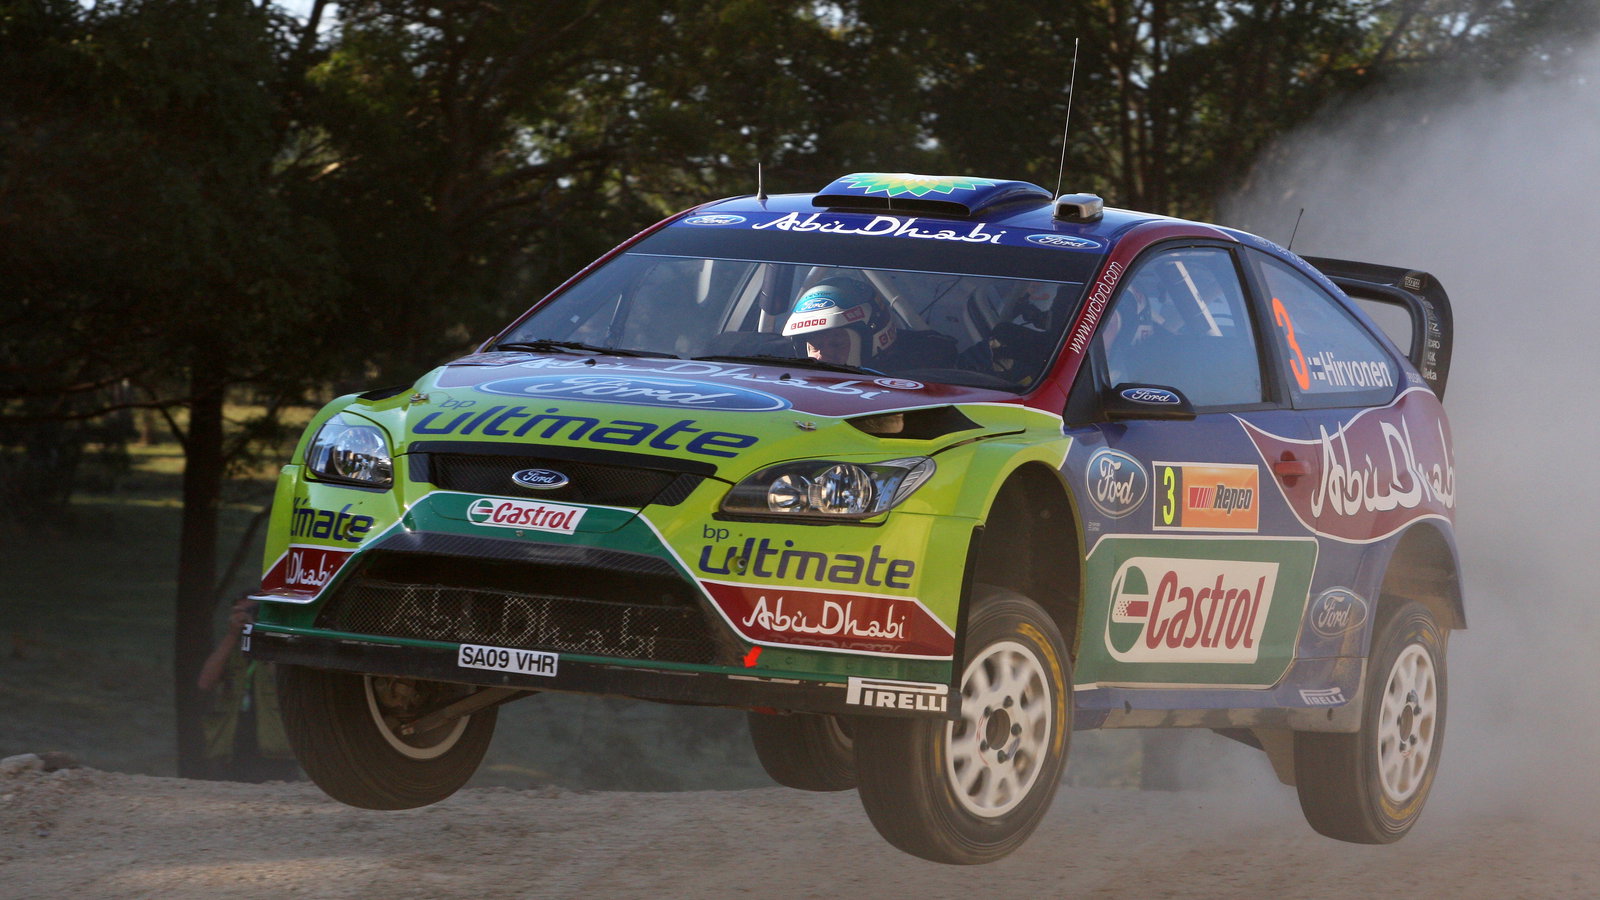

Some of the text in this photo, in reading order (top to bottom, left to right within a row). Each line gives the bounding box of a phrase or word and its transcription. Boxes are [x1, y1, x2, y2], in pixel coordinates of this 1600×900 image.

[696, 213, 734, 225] Ford
[1037, 233, 1089, 248] Ford
[1069, 261, 1123, 354] www.wrcford.com
[1272, 298, 1394, 390] 3 Hirvonen
[524, 376, 737, 404] Ford
[1132, 387, 1169, 402] Ford
[440, 398, 475, 411] bp
[411, 404, 759, 458] ultimate
[521, 469, 556, 484] Ford
[1097, 457, 1134, 504] Ford
[1163, 466, 1175, 525] 3
[1213, 484, 1253, 512] Repco
[493, 502, 576, 530] Castrol
[703, 524, 729, 542] bp
[699, 538, 914, 588] ultimate
[1146, 570, 1266, 650] Castrol
[1319, 596, 1352, 628] Ford
[461, 646, 555, 674] SA09 VHR
[846, 676, 949, 712] PIRELLI
[1299, 686, 1346, 705] PIRELLI
